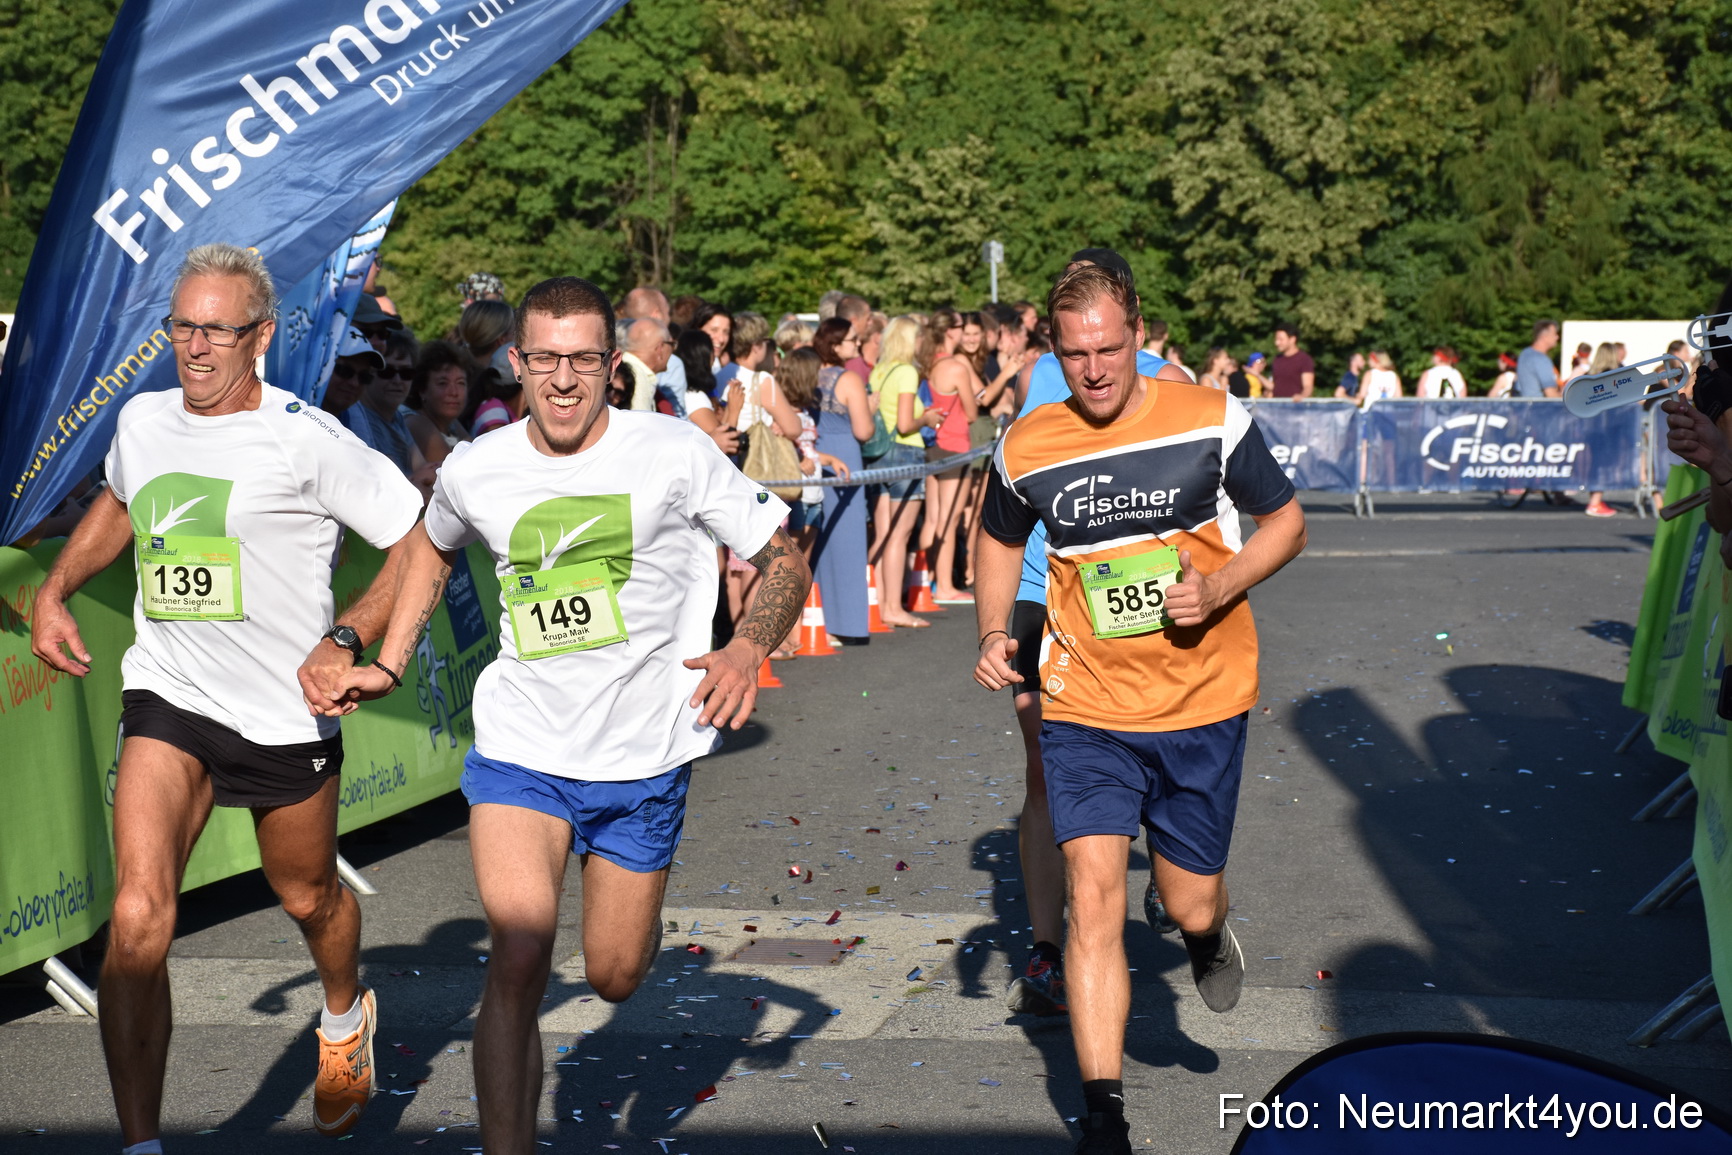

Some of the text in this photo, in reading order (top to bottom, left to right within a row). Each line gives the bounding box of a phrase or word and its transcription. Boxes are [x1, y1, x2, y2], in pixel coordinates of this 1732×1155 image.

[369, 23, 471, 106] Druck
[302, 409, 340, 439] Bionorica
[1449, 437, 1585, 464] Fischer
[1461, 465, 1573, 479] AUTOMOBILE
[1073, 487, 1181, 519] Fischer
[1087, 508, 1174, 529] AUTOMOBILE
[154, 564, 212, 597] 139
[150, 595, 222, 607] Haubner Siegfried
[1106, 579, 1164, 615] 585
[530, 595, 592, 633] 149
[1108, 623, 1126, 631] Fischer
[1127, 618, 1157, 628] Automobile
[542, 626, 590, 642] Krupa Maik
[549, 639, 577, 648] Bionorica
